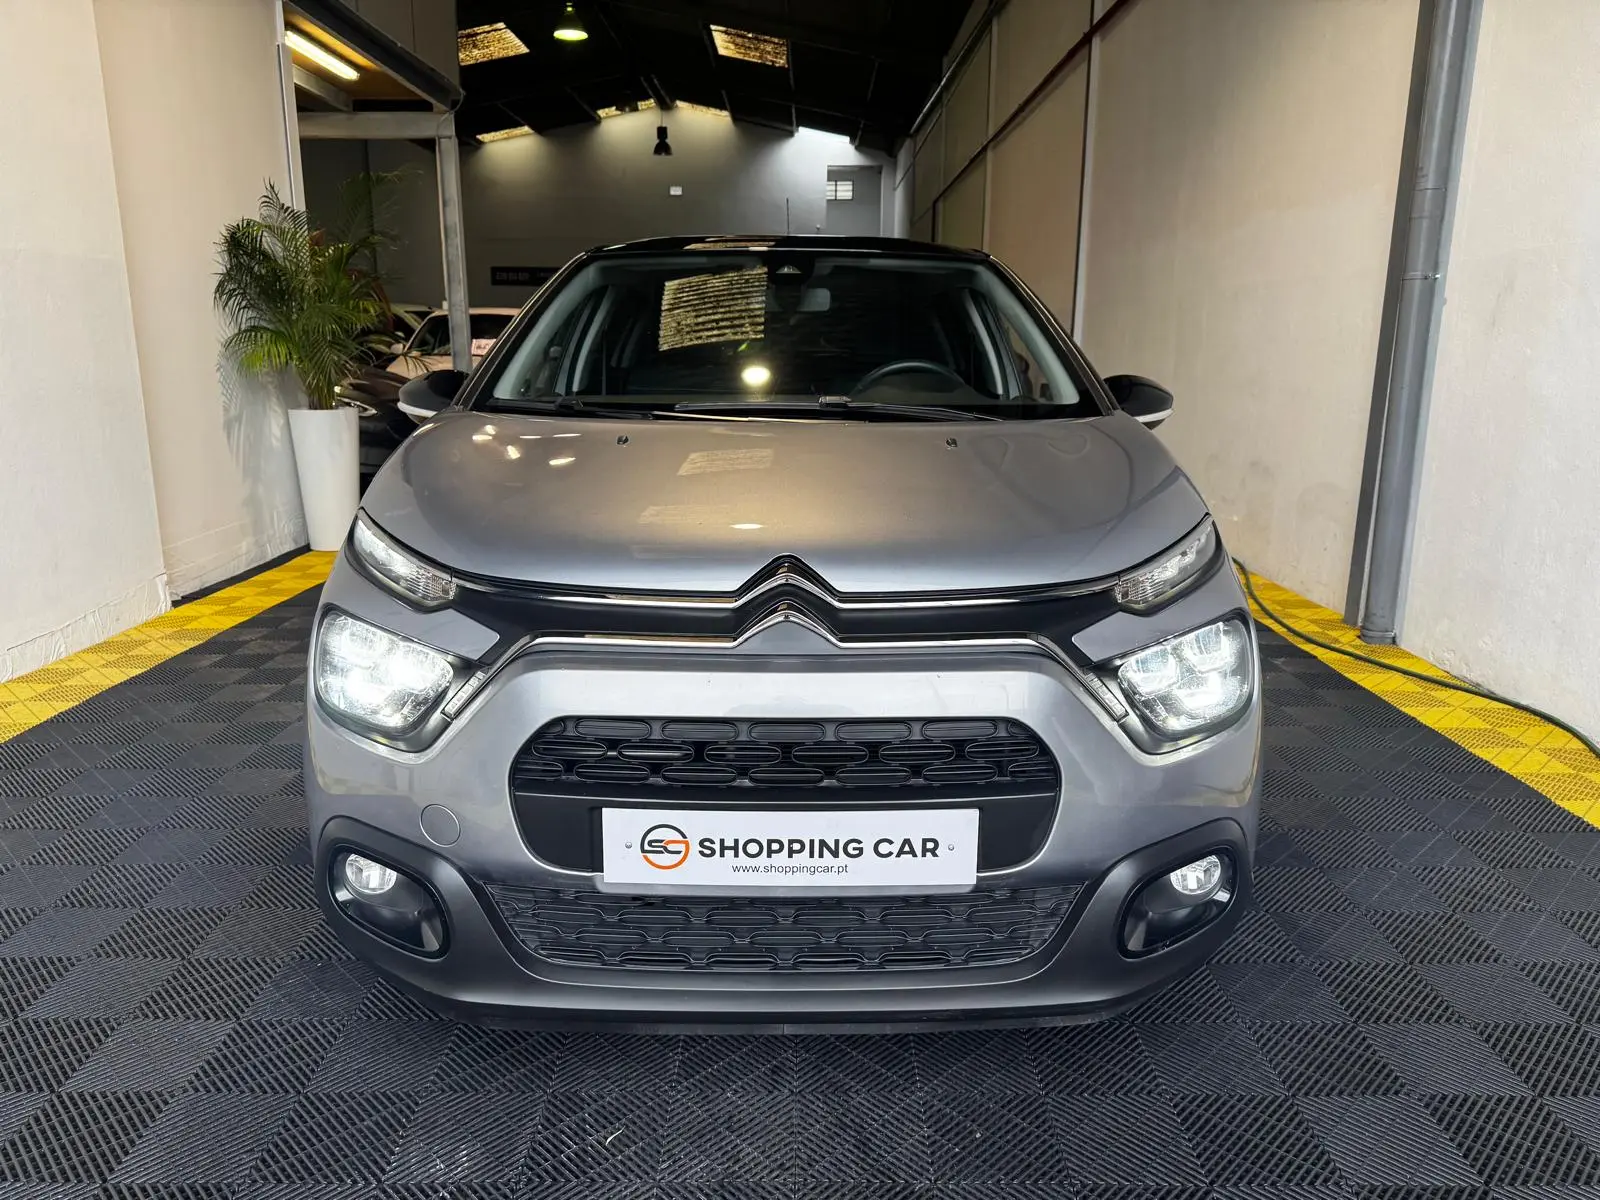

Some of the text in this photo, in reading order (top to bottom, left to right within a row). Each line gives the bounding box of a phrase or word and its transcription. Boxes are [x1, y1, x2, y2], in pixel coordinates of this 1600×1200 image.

[698, 837, 940, 859] SHOPPING CAR
[731, 863, 849, 876] www.shoppingcar.pt
